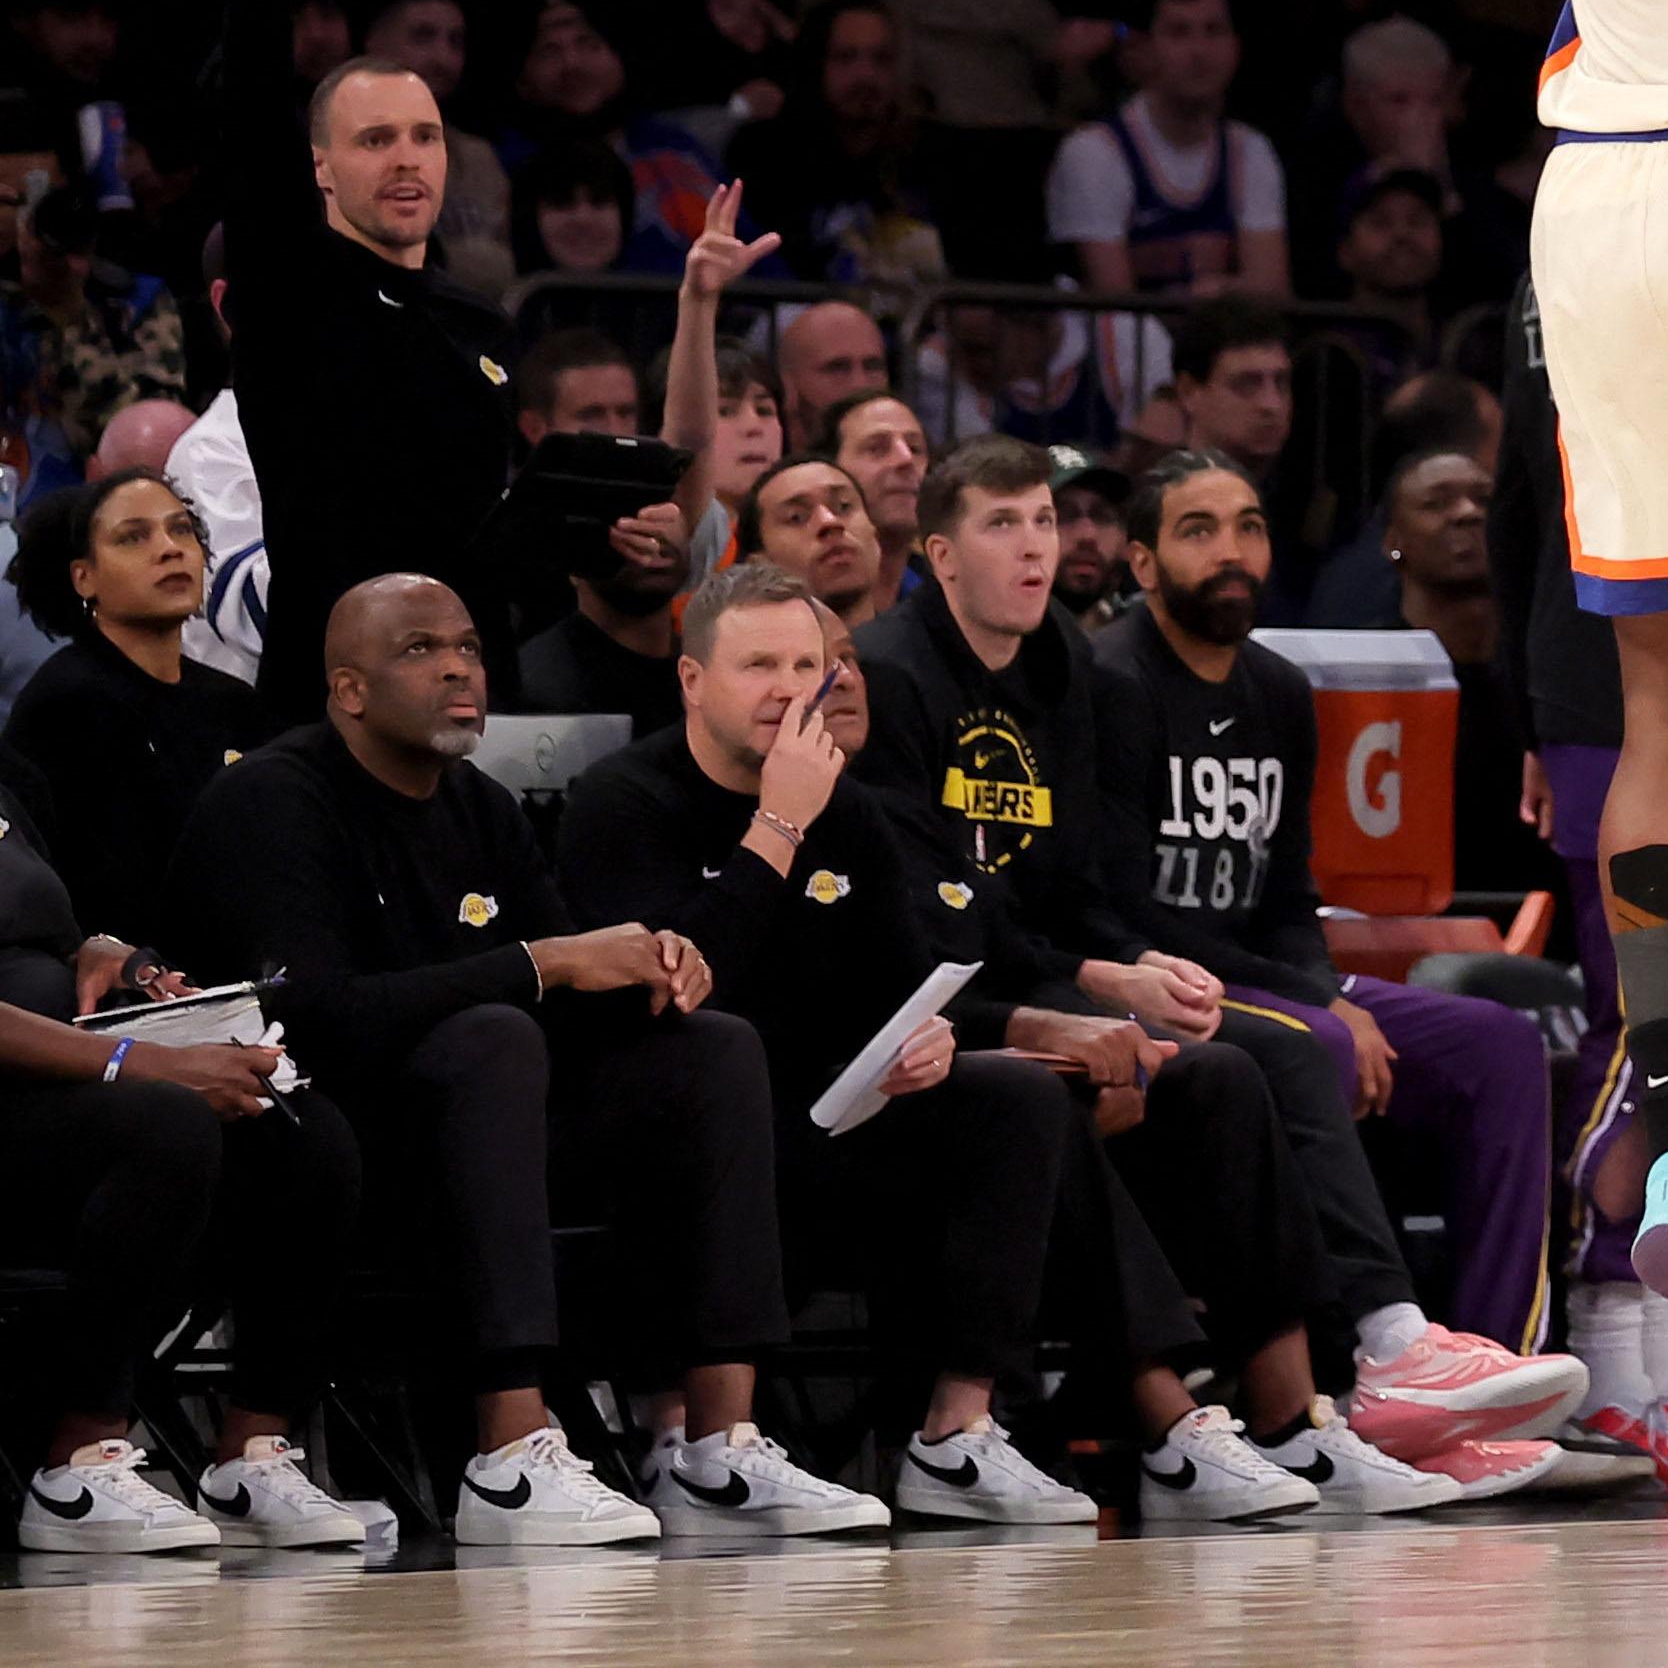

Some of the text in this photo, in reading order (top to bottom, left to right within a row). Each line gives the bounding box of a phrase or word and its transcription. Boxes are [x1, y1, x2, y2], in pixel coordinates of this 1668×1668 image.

[1159, 755, 1284, 841] 1950
[1346, 718, 1401, 839] G
[1210, 848, 1236, 911] 8
